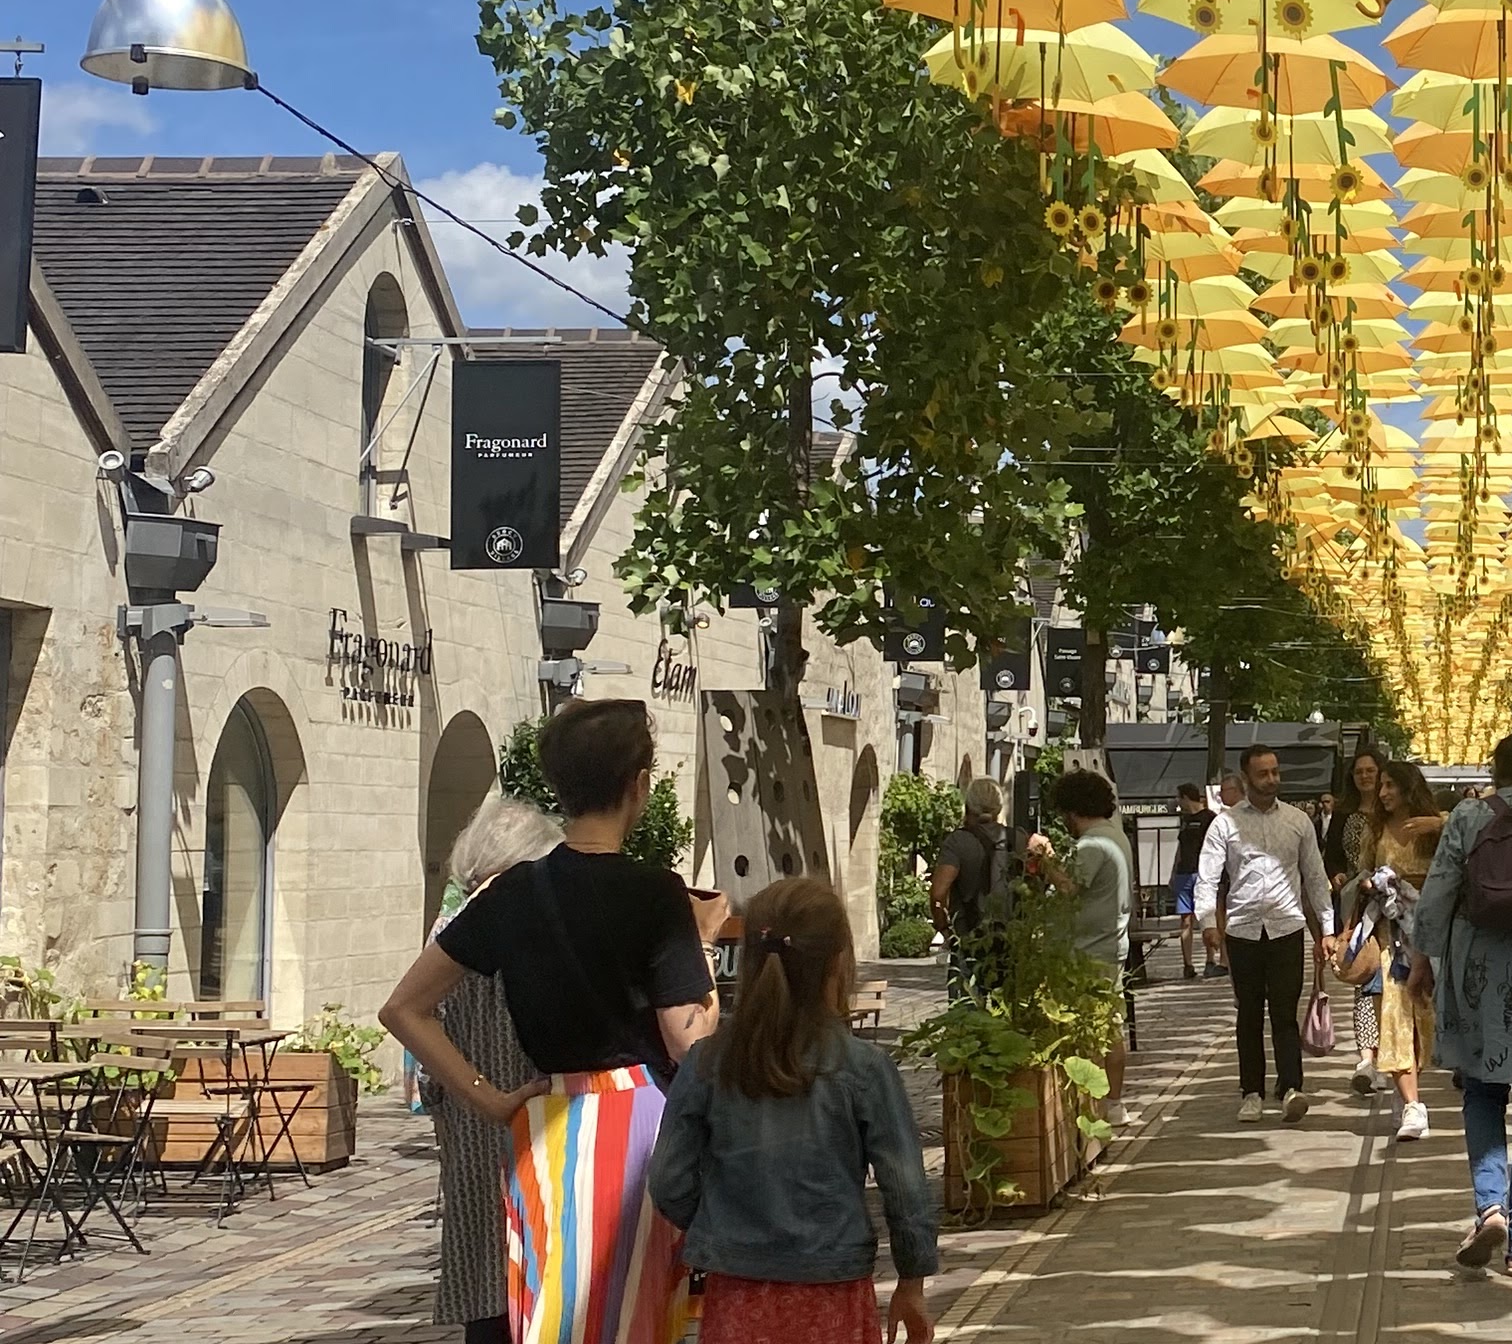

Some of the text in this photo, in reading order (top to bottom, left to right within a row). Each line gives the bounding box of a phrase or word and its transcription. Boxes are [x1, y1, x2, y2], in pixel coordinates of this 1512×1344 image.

[464, 432, 548, 453] Fragonard
[326, 606, 433, 683] Fragonard
[651, 637, 698, 695] Etam
